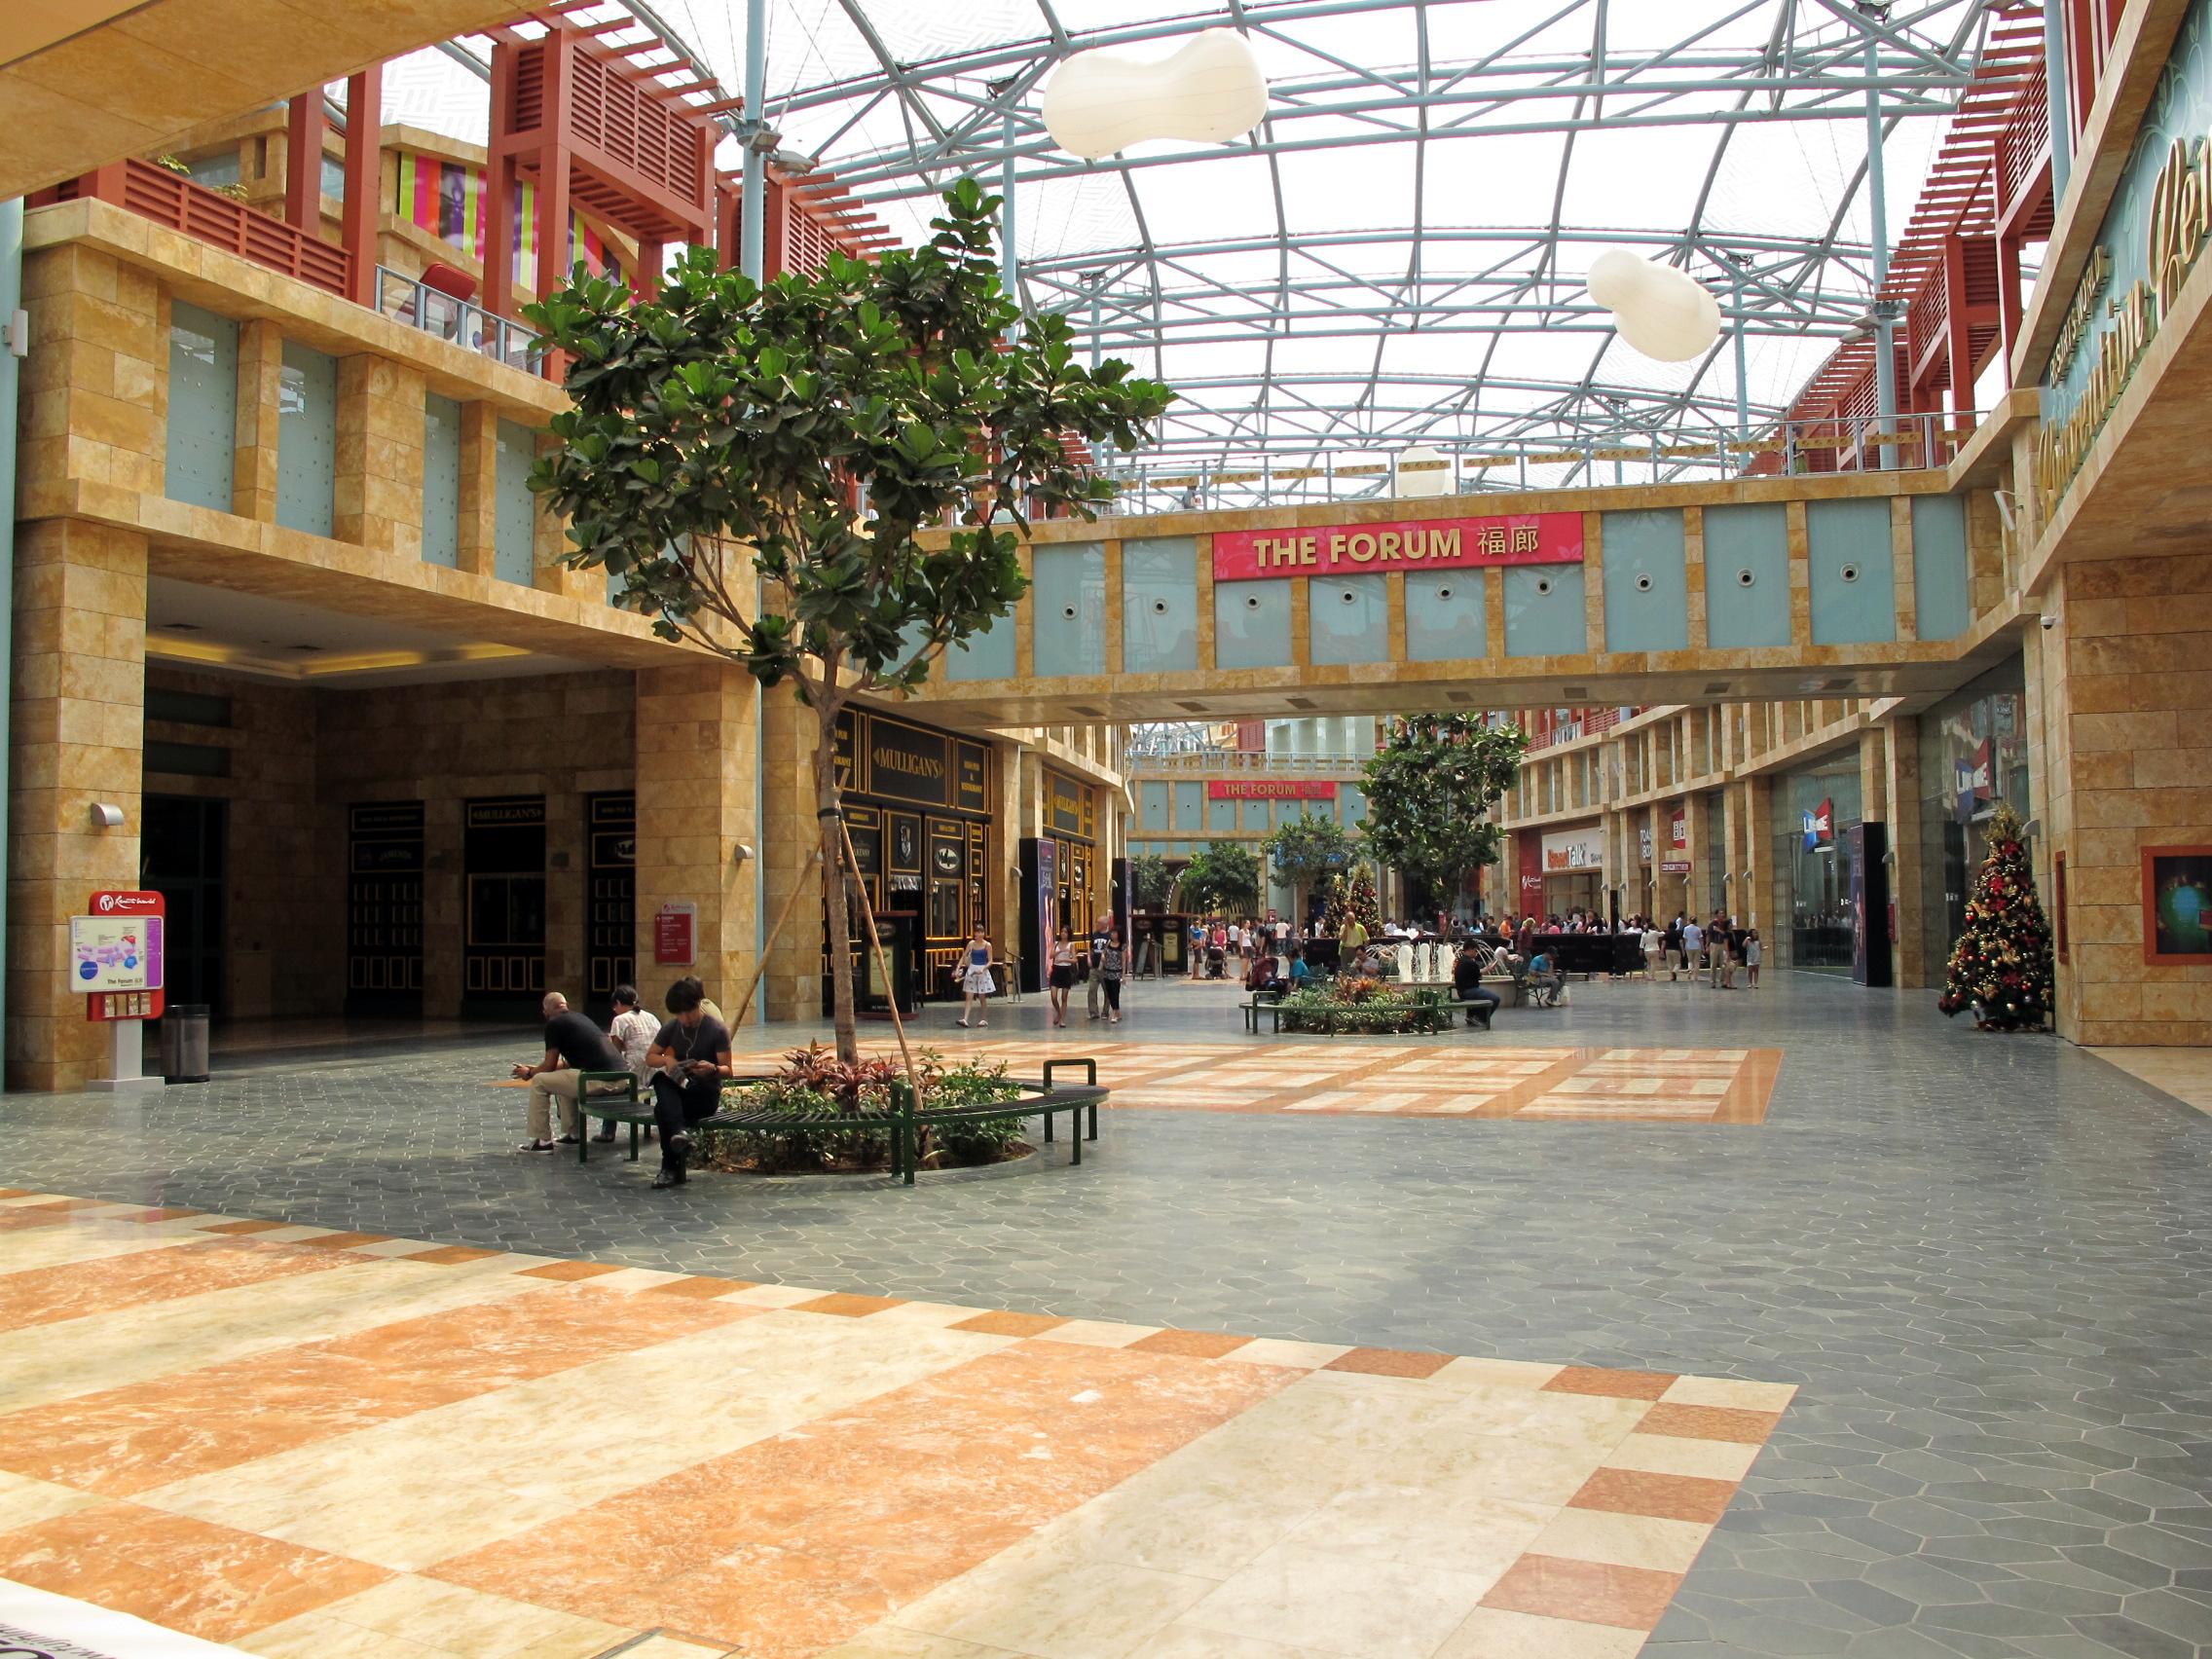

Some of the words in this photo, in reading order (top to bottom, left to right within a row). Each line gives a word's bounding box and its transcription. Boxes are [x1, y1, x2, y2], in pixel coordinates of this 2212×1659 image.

[1252, 536, 1317, 568] THE
[1330, 528, 1463, 564] FORUM
[1476, 523, 1539, 556] 福廊
[880, 748, 940, 779] MULLIGAN'S
[1224, 784, 1247, 795] THE
[1250, 784, 1296, 795] FORUM
